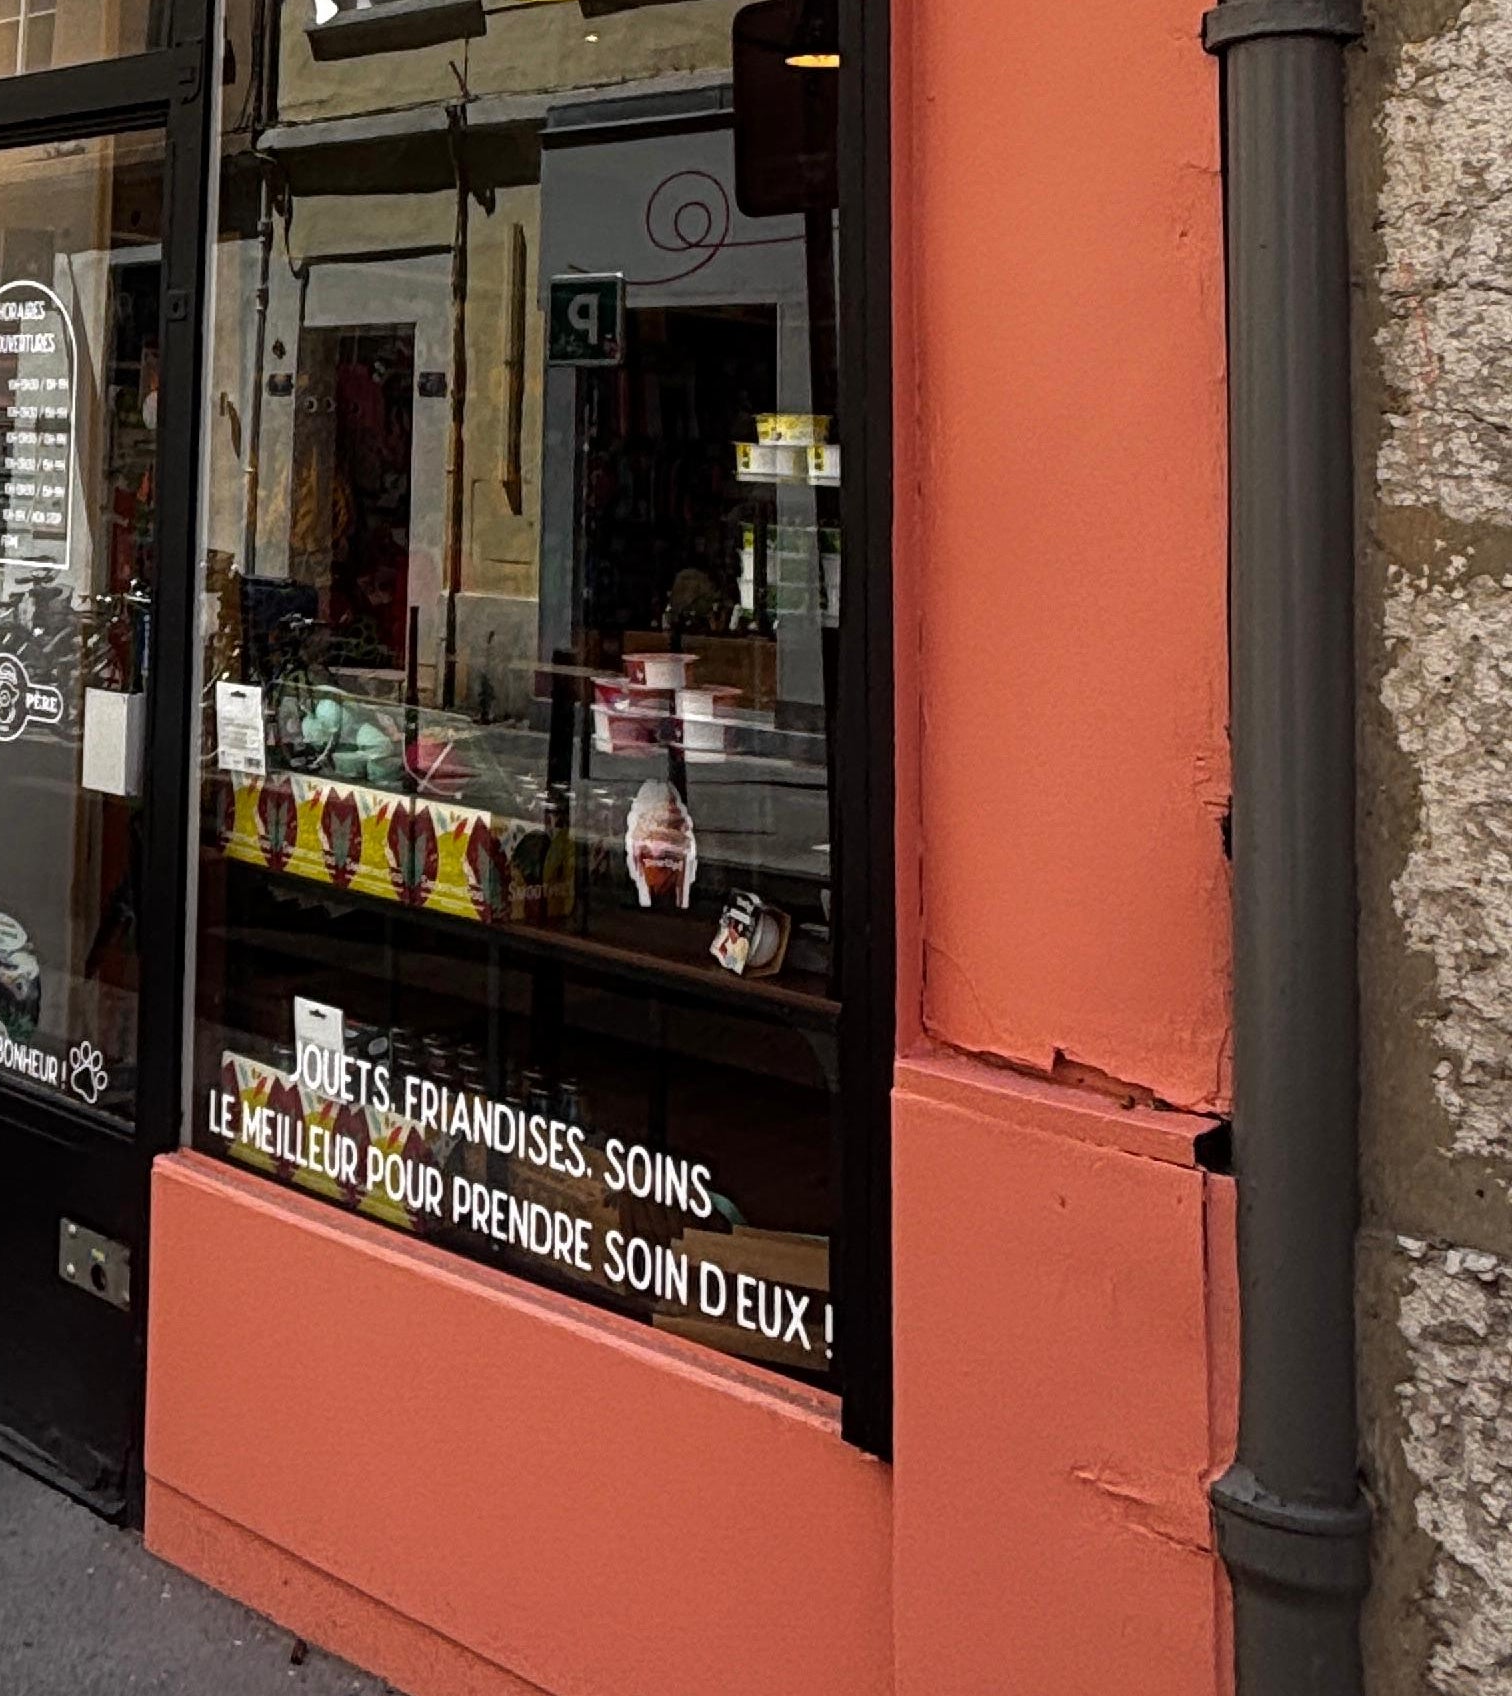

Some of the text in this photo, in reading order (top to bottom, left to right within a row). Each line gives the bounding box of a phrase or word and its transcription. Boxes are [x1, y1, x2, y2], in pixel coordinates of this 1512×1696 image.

[209, 1089, 237, 1140] LE
[242, 1101, 358, 1186] MEILLEUR
[366, 1145, 443, 1218] POUR
[452, 1176, 592, 1272] PRENDRE
[603, 1229, 688, 1306] SOIN
[603, 1138, 713, 1219] SOINS
